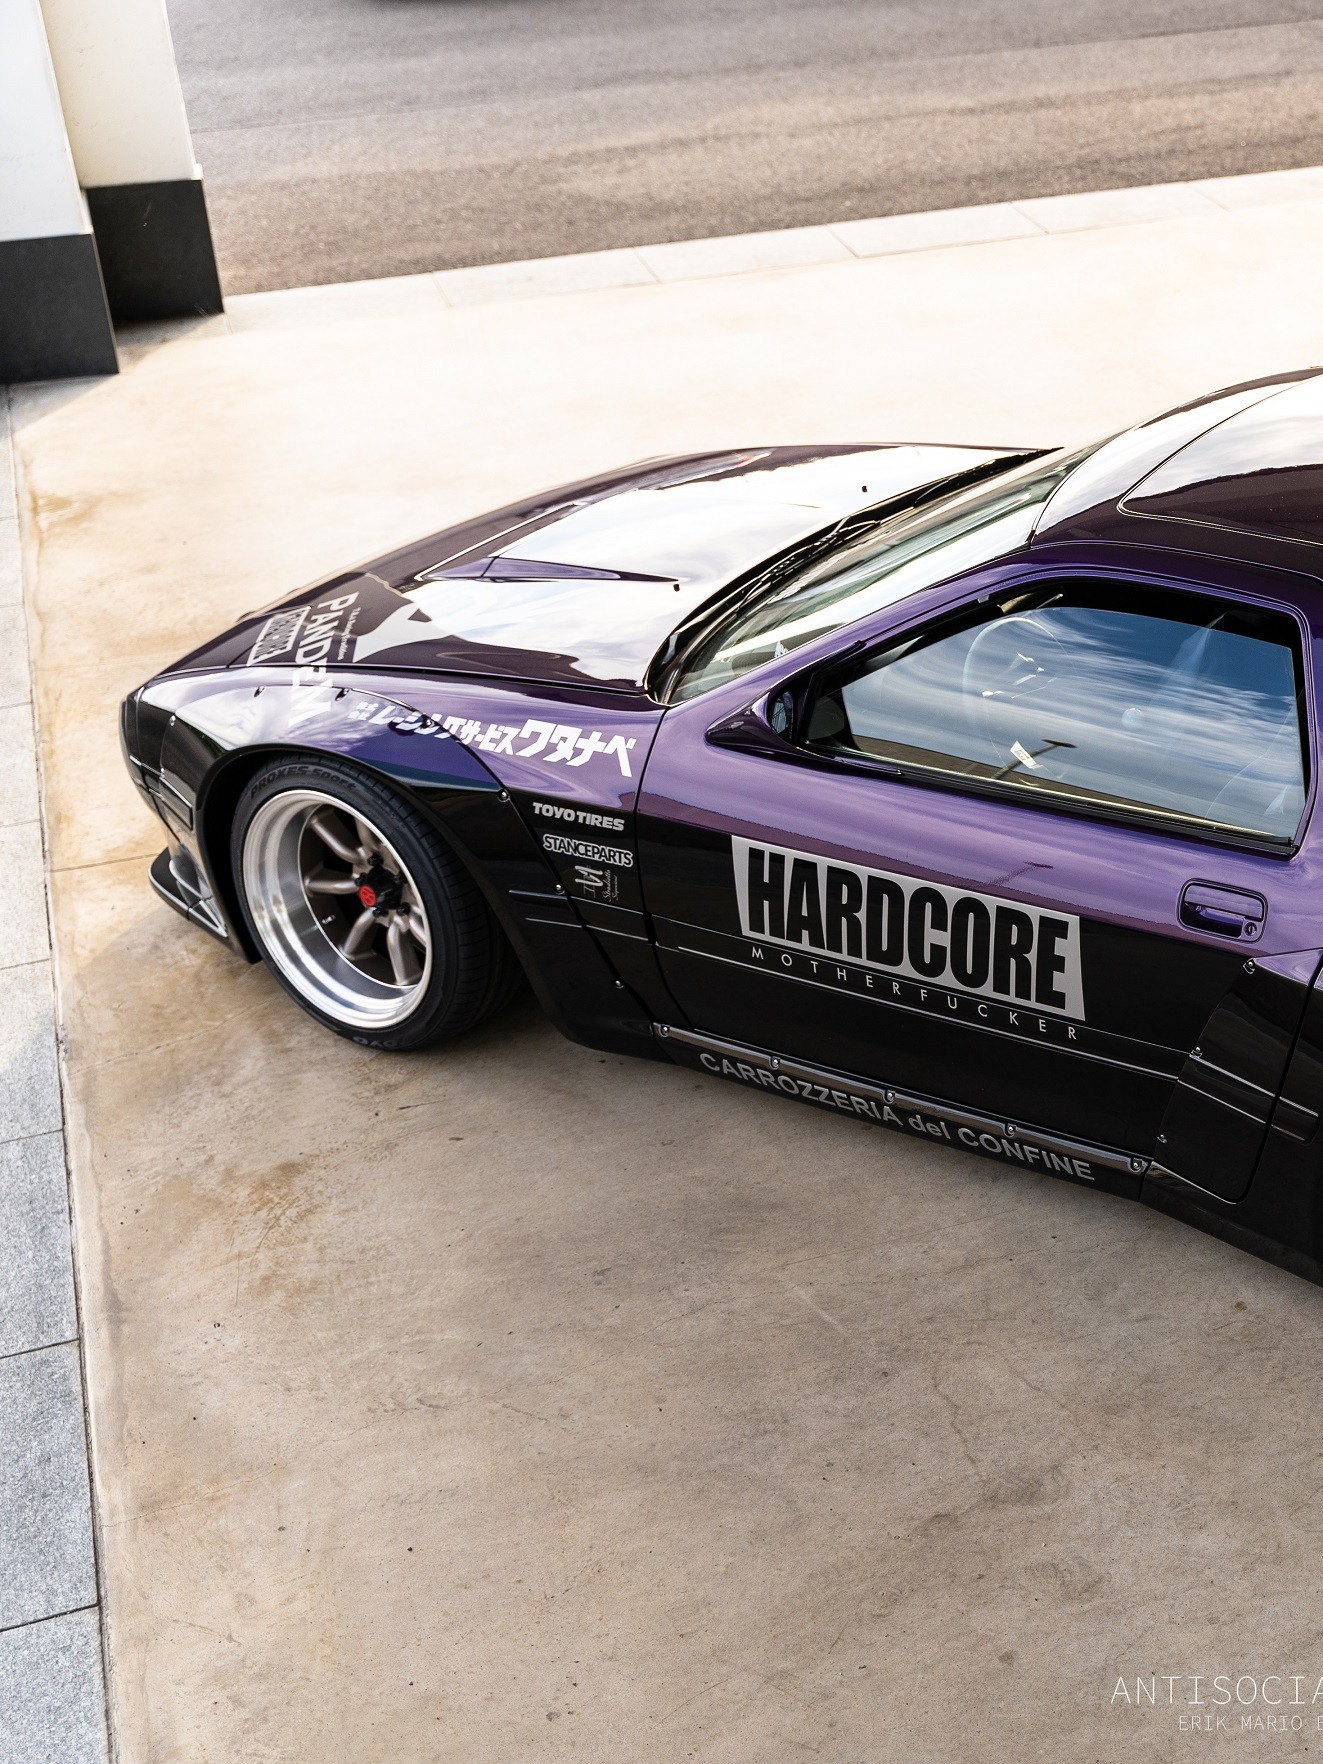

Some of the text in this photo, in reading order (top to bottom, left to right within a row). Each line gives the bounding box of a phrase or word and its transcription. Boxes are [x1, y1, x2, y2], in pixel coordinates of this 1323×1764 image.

[250, 765, 309, 799] PROXES
[532, 801, 625, 832] TOYO TIRES
[543, 833, 634, 868] STANCEPARTS
[746, 845, 1070, 1011] HARDCORE
[750, 946, 1077, 1041] MOTHERFUCKER
[699, 1052, 1096, 1182] CARROZZERIA del CONFINE
